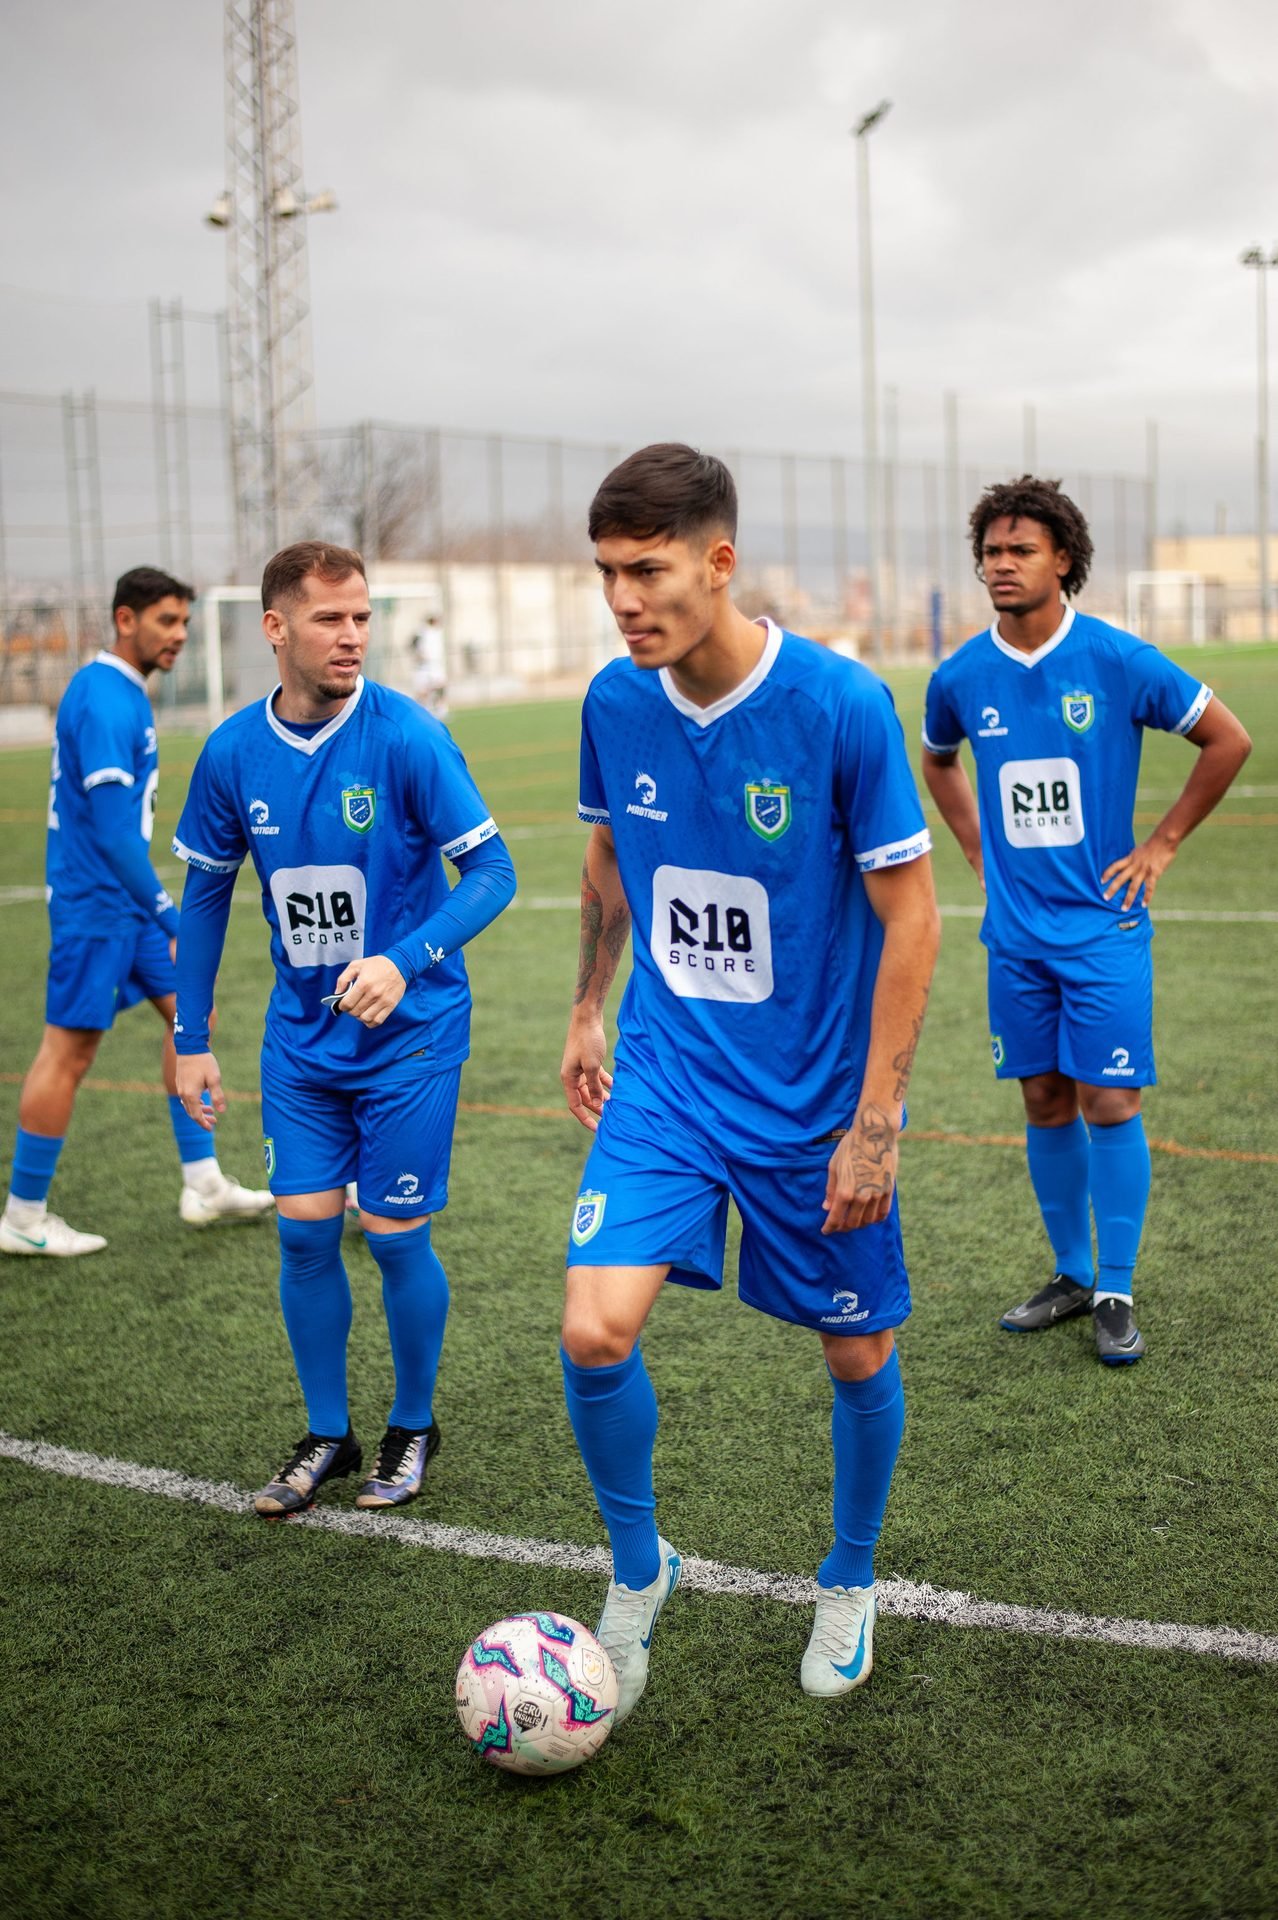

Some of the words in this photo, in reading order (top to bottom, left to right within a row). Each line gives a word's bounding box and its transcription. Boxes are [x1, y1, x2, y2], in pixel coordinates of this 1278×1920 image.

[1011, 781, 1069, 814] R10
[626, 804, 668, 822] MADTIGER
[1014, 816, 1072, 828] SCORE
[286, 891, 356, 931] R10
[669, 898, 752, 953] R10
[292, 929, 359, 945] SCORE
[669, 950, 755, 973] SCORE
[820, 1309, 869, 1324] MADTIGER
[518, 1702, 541, 1717] ZERO
[514, 1711, 542, 1726] INSULTS
